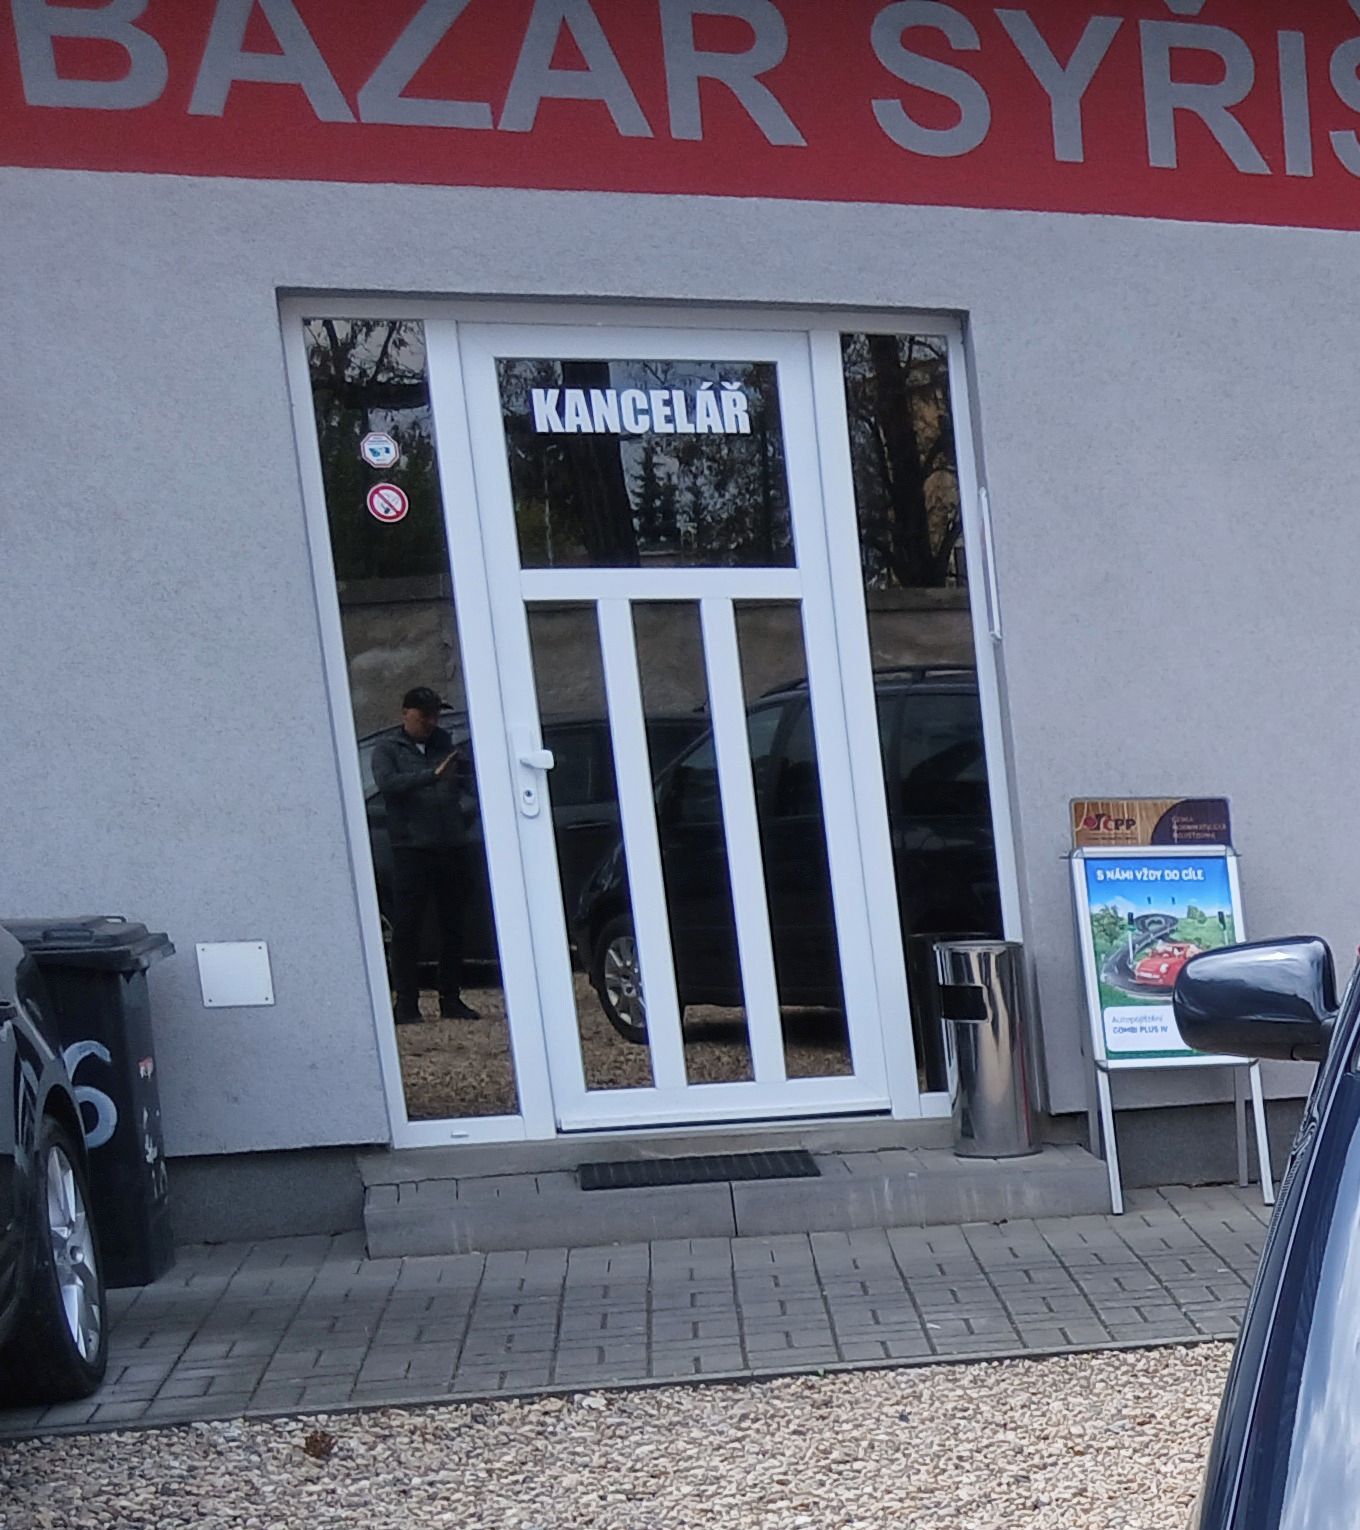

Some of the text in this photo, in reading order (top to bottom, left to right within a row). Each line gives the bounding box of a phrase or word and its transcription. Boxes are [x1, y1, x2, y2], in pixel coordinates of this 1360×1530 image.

[12, 0, 807, 147] BAZAR
[531, 381, 751, 434] KANCELÁŘ
[1096, 867, 1205, 881] S NÁMI VŽDY DO CÍLE
